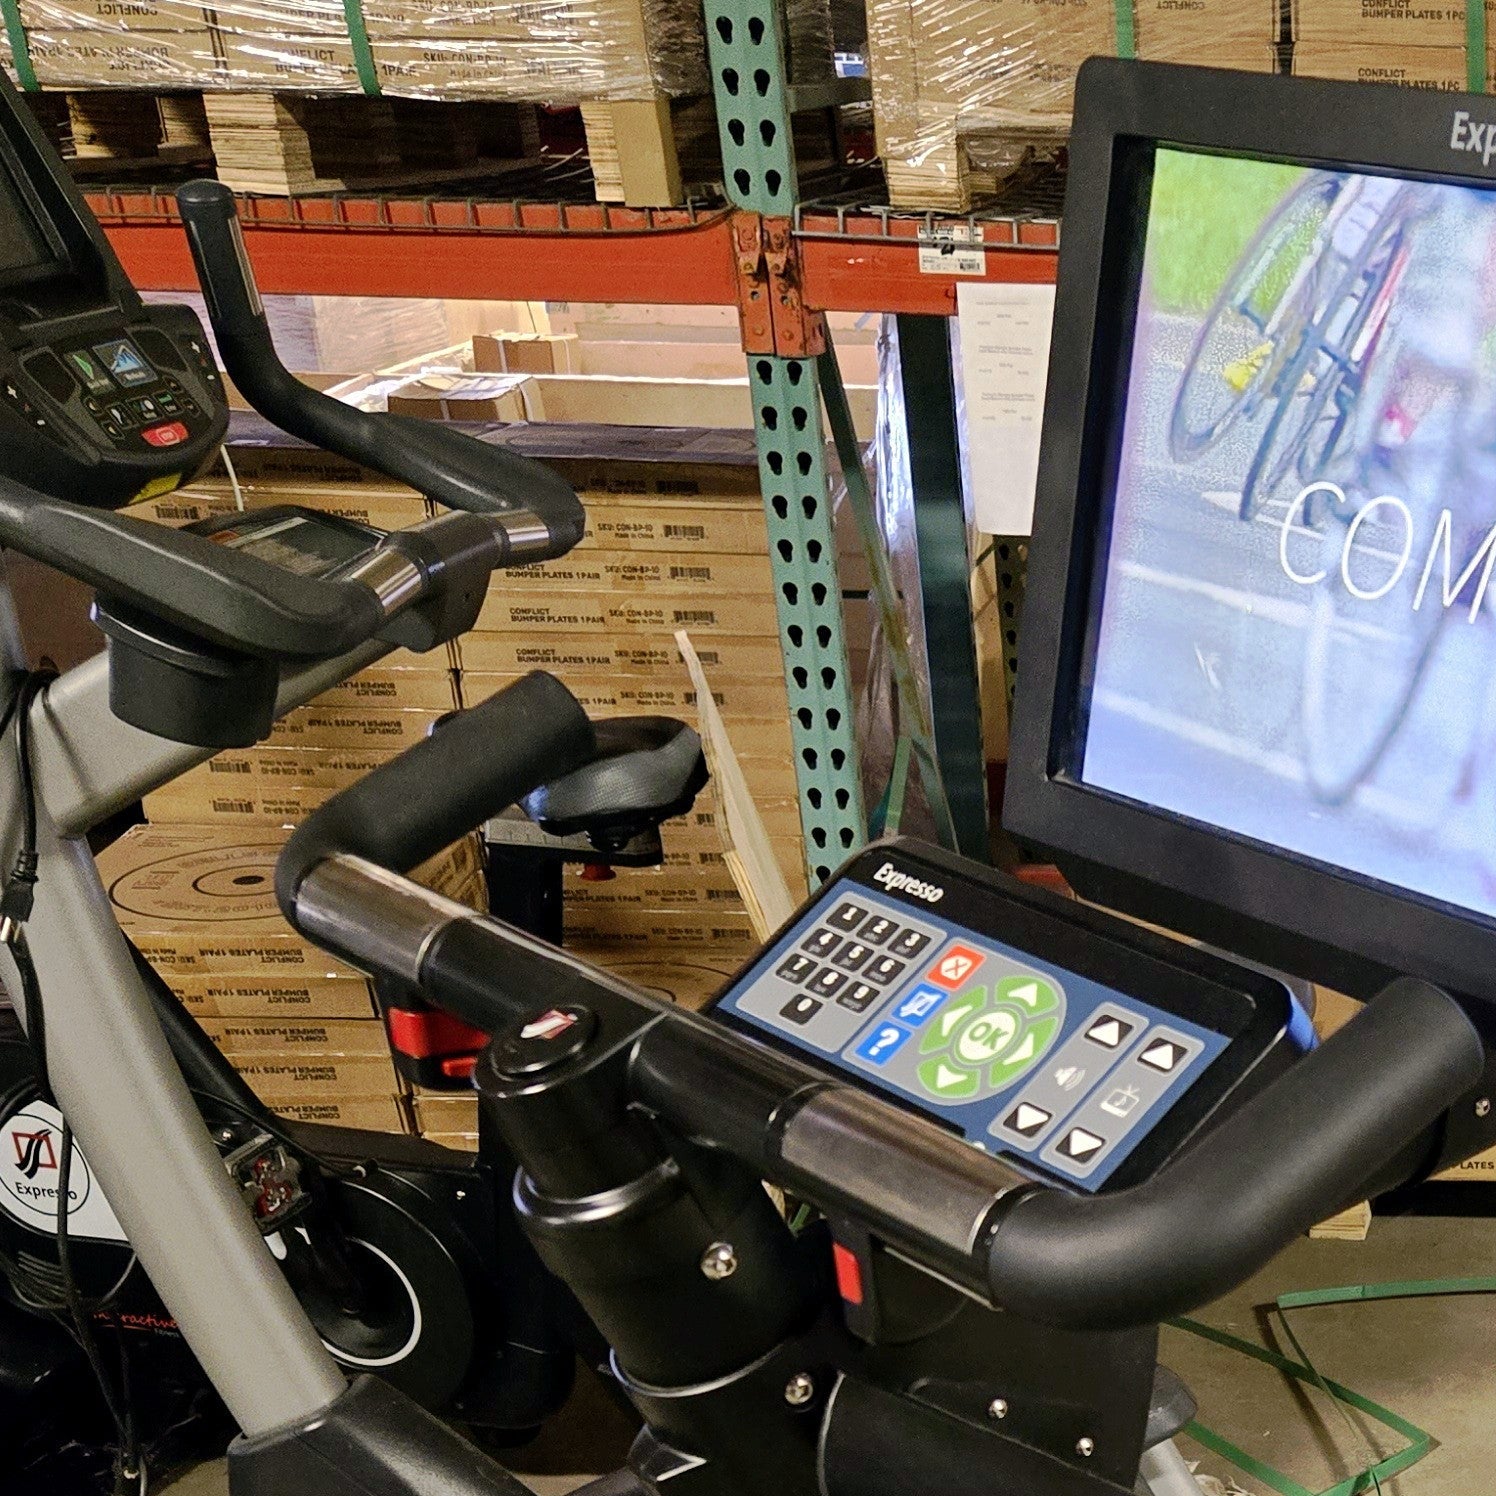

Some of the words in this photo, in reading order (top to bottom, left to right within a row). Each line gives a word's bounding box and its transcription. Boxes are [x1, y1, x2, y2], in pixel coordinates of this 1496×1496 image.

[1362, 8, 1403, 19] BUMPER
[1405, 10, 1443, 20] PLATES
[1358, 67, 1406, 78] CONFLICT
[505, 571, 540, 580] BUMPER
[541, 571, 574, 580] PLATES
[510, 607, 550, 616] CONFLICT
[511, 615, 544, 623] BUMPER
[546, 615, 578, 624] PLATES
[515, 648, 556, 656] CONFLICT
[517, 655, 550, 664] BUMPER
[551, 656, 584, 664] PLATES
[362, 681, 395, 690] BUMPER
[334, 719, 366, 727] PLATES
[367, 719, 402, 727] BUMPER
[872, 860, 945, 904] Expresso
[842, 907, 857, 921] 1
[873, 919, 889, 934] 2
[819, 932, 834, 946] 4
[905, 932, 921, 947] 3
[229, 948, 263, 956] PLATES
[265, 948, 303, 956] BUMPER
[848, 945, 865, 959] 5
[261, 956, 305, 964] CONFLICT
[792, 957, 809, 971] 7
[880, 958, 896, 973] 6
[822, 971, 839, 985] 8
[236, 988, 270, 997] PLATES
[272, 988, 309, 997] BUMPER
[853, 985, 870, 999] 9
[267, 996, 311, 1004] CONFLICT
[797, 998, 813, 1012] 0
[968, 1022, 1004, 1050] OK
[262, 1066, 296, 1074] PLATES
[298, 1066, 336, 1074] BUMPER
[293, 1074, 338, 1082] CONFLICT
[302, 1105, 339, 1114] BUMPER
[298, 1112, 341, 1120] CONFLICT
[1460, 1161, 1495, 1170] LATES
